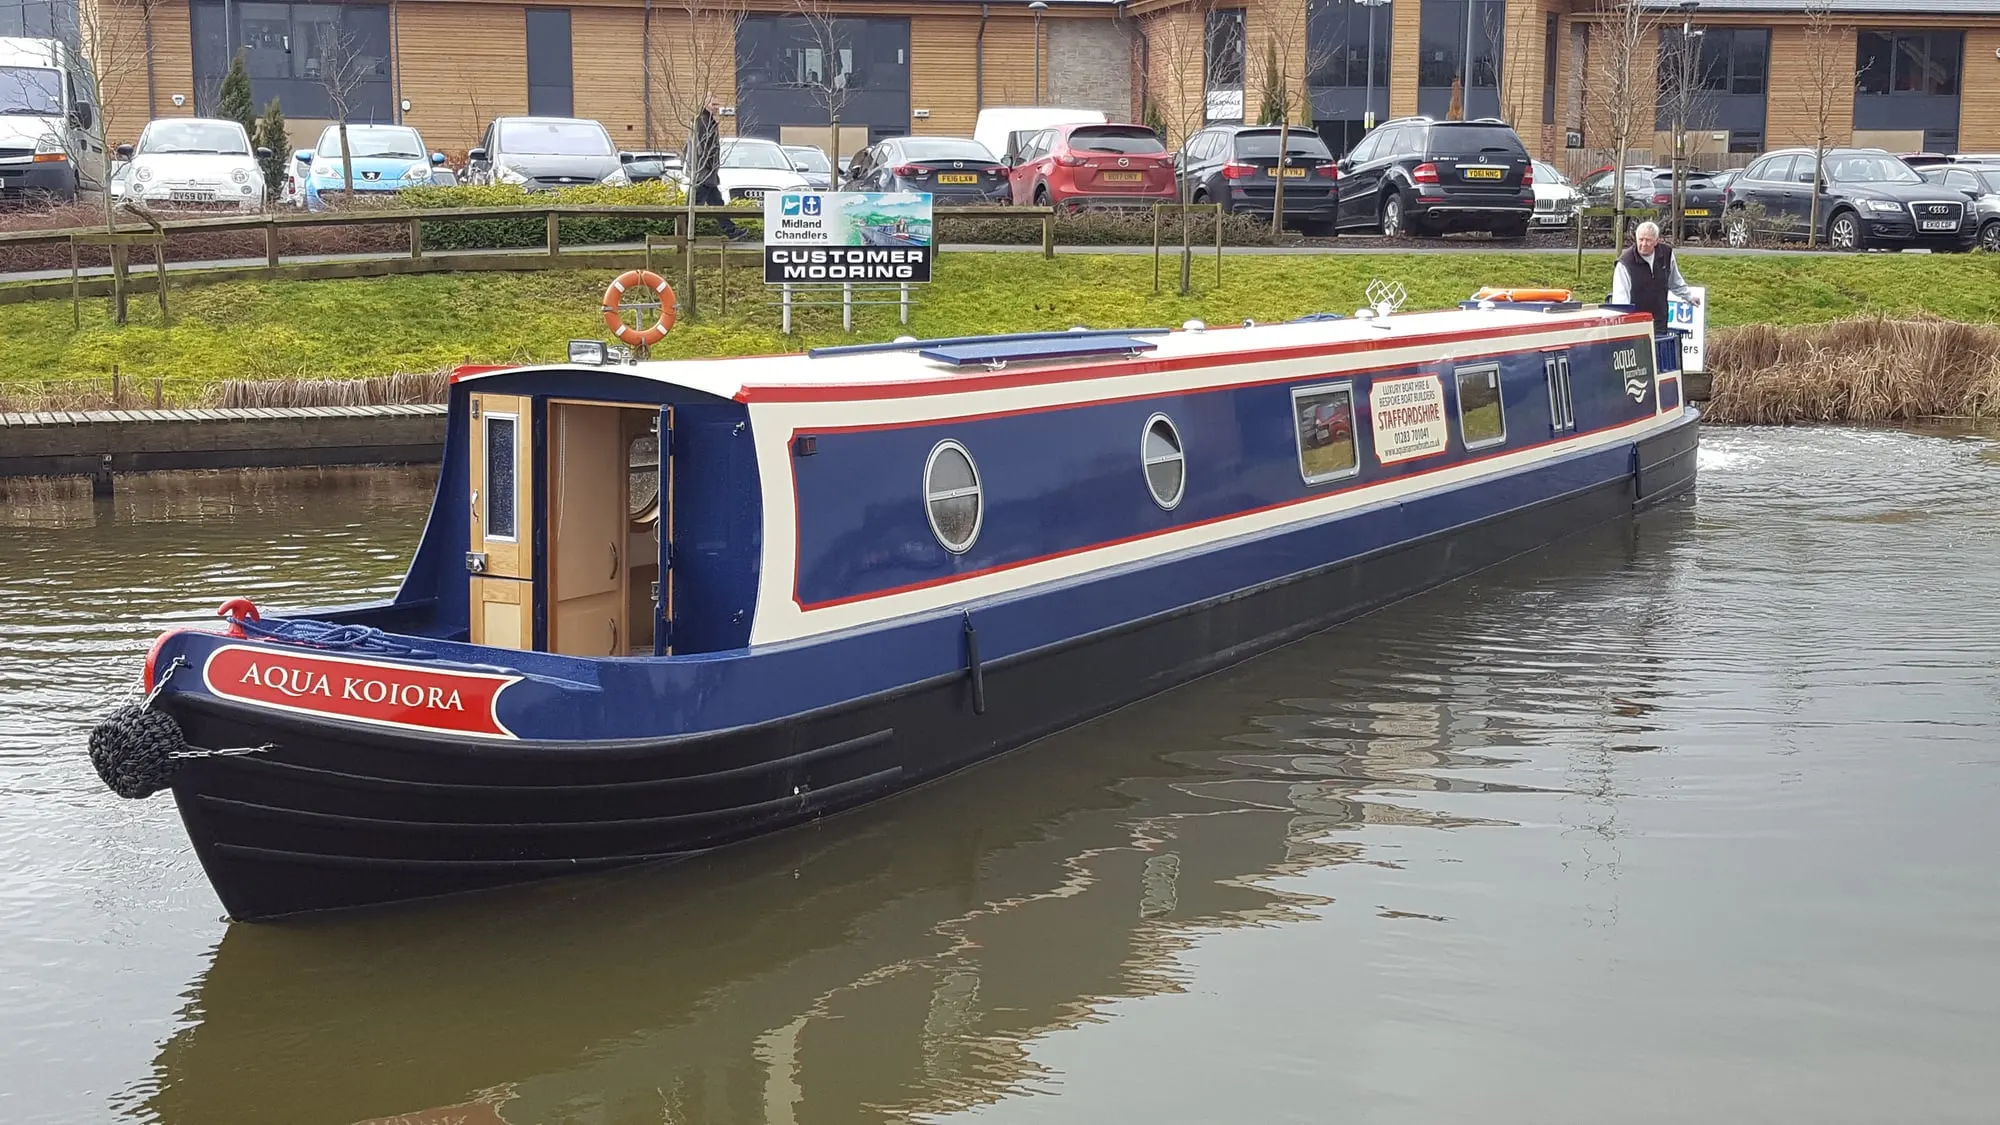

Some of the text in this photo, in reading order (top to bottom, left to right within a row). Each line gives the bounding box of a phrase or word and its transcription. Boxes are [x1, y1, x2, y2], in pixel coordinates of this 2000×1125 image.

[781, 219, 822, 229] Midland
[774, 230, 828, 240] Chandlers
[772, 250, 923, 264] CUSTOMER
[783, 265, 913, 279] MOORING
[1382, 383, 1402, 395] LUXURY
[1402, 382, 1414, 393] BOAT
[1415, 380, 1426, 391] HIRE
[1379, 390, 1435, 407] BESPOKE BOAT BUILDERS
[1378, 403, 1440, 431] STAFFORDSHIRE
[1394, 430, 1410, 445] 01283
[239, 662, 465, 711] AQUA KOIORA
